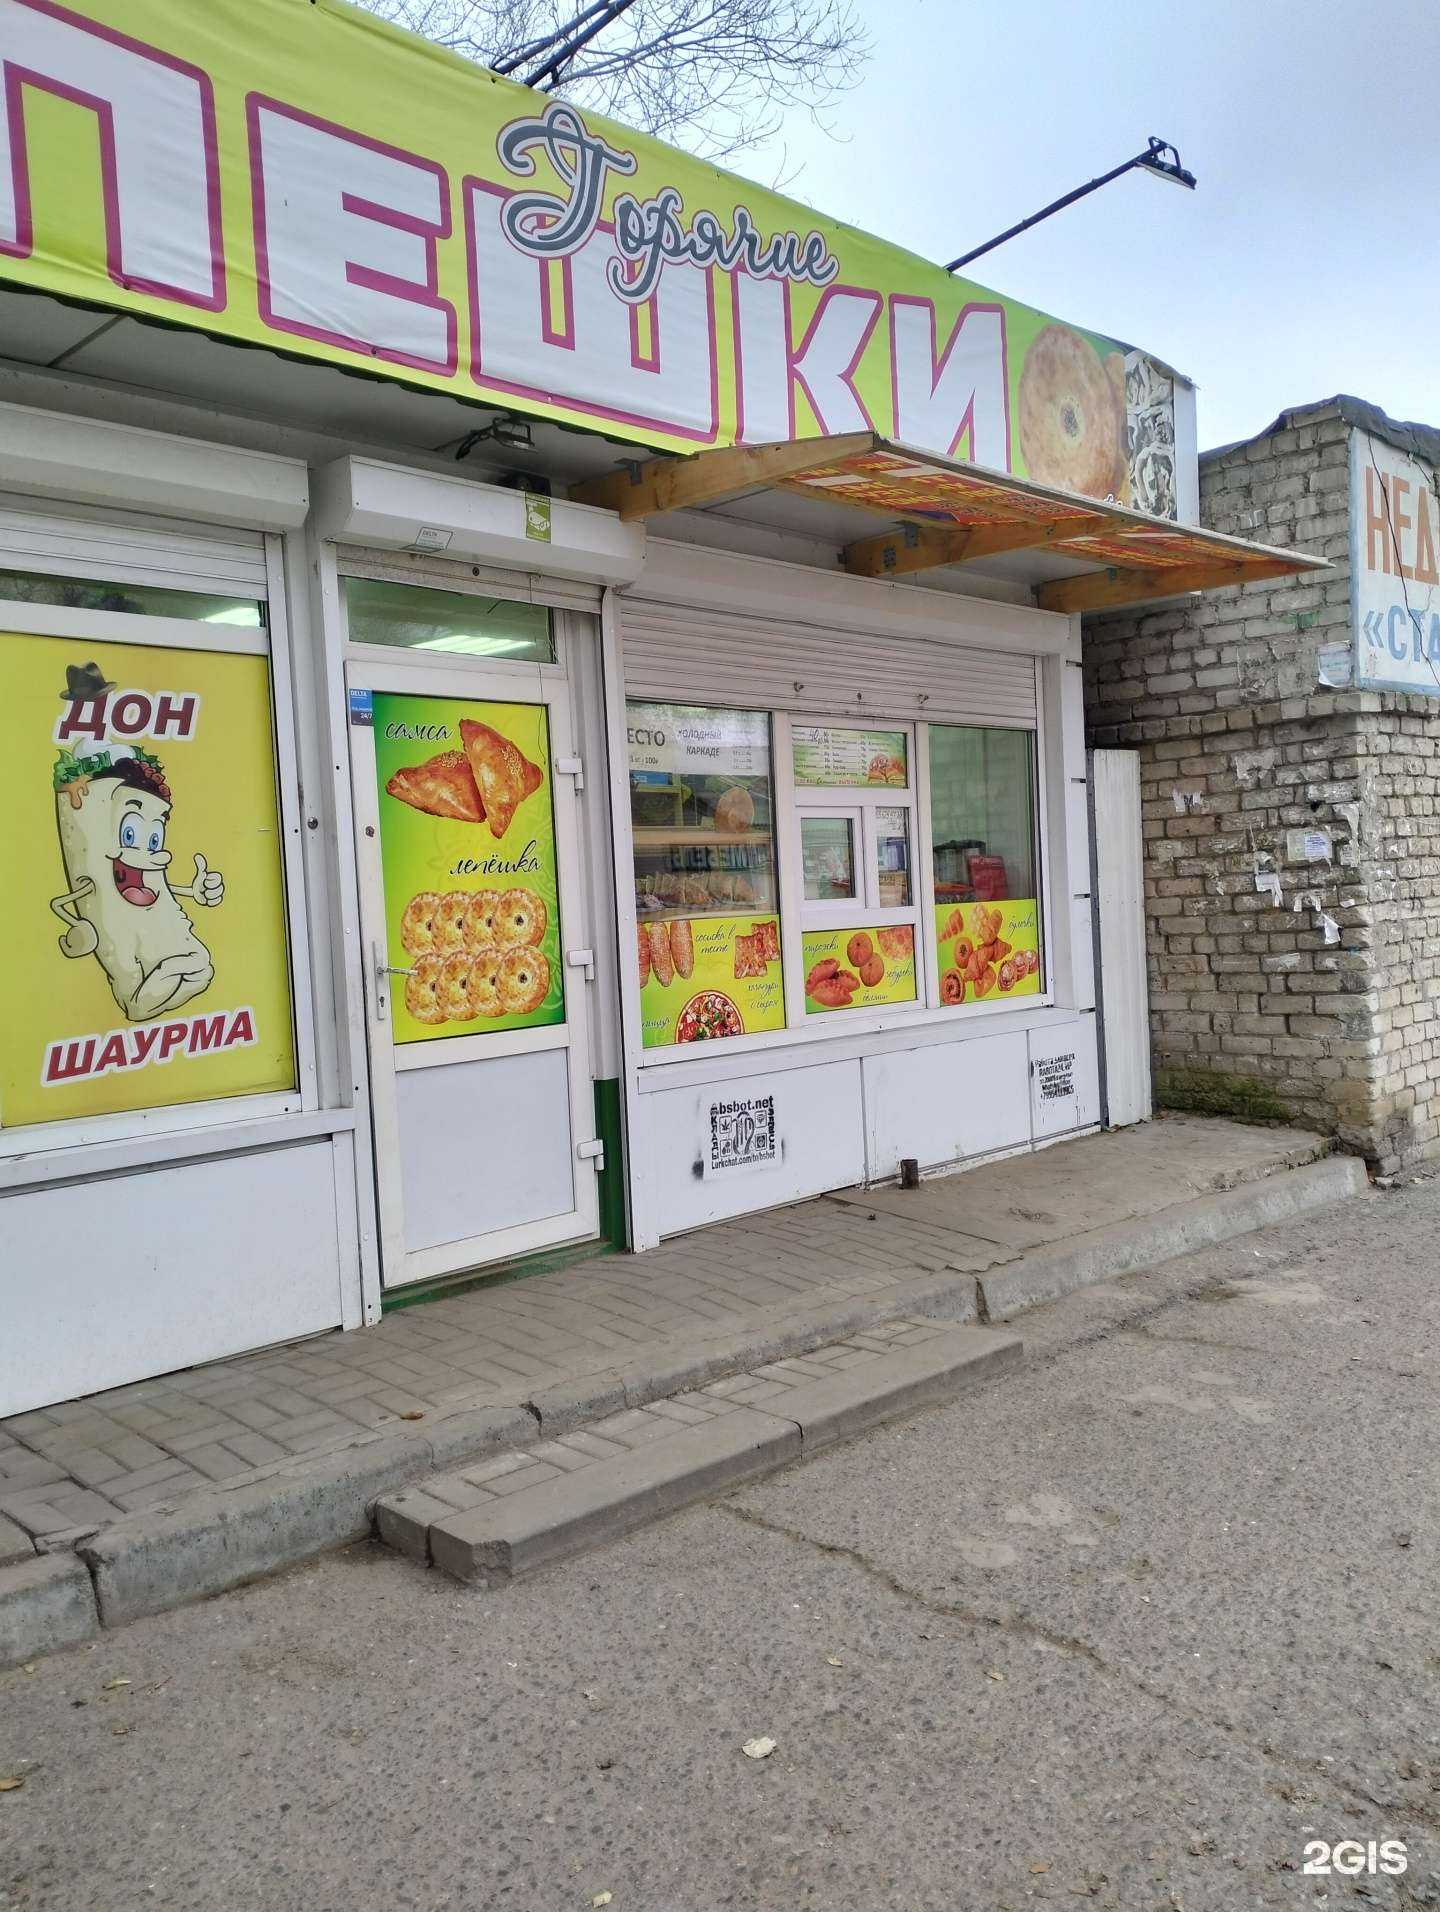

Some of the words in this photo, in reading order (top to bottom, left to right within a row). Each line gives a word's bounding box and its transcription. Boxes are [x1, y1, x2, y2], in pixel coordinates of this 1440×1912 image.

[498, 103, 838, 301] Горячие
[1365, 466, 1440, 585] НЕД
[58, 693, 197, 741] ДОН
[384, 722, 453, 741] самса
[686, 745, 721, 758] КАРКАДЕ
[449, 839, 543, 875] лепёшка
[46, 1011, 254, 1082] ШАУРМА
